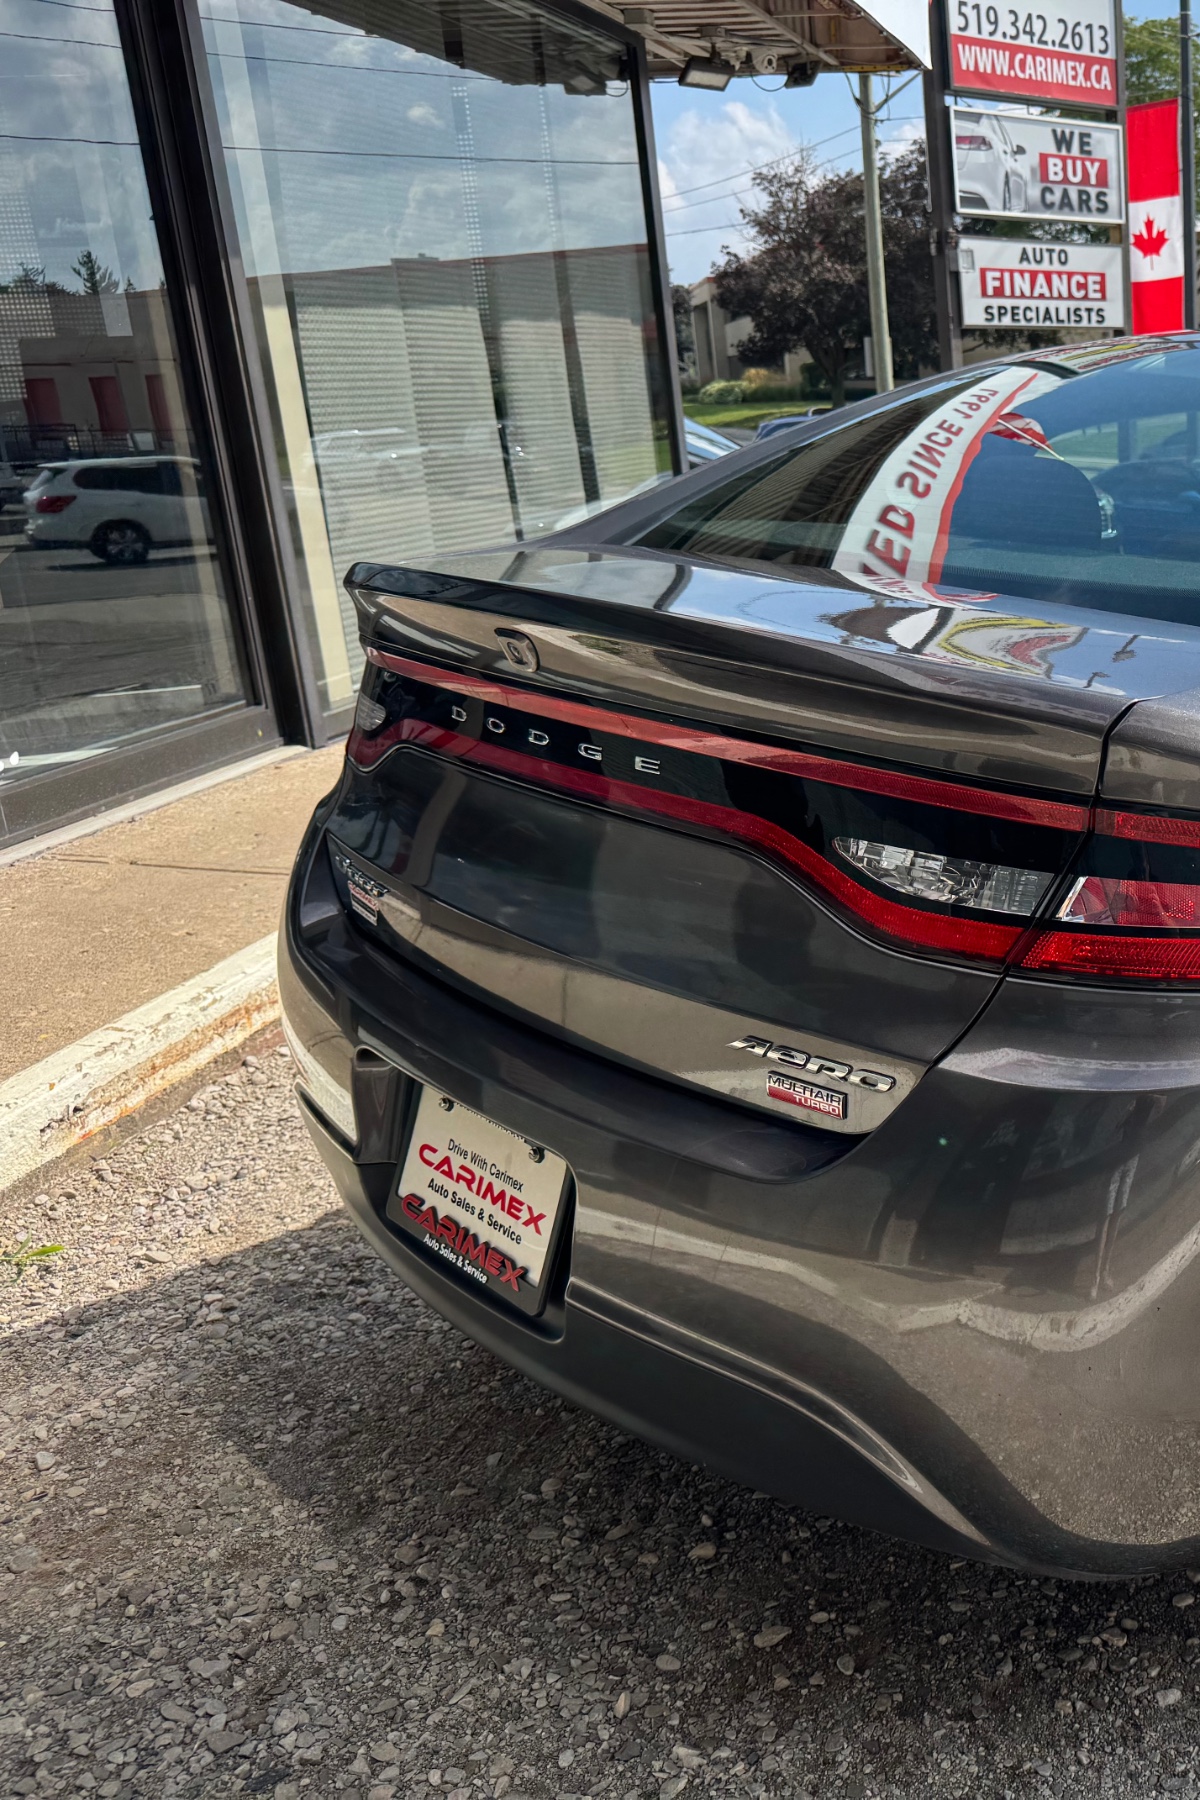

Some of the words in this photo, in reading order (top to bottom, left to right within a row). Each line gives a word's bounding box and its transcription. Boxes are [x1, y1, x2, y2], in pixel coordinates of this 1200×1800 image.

[957, 1, 1110, 55] 519.342.2613
[957, 43, 1112, 90] WWW.CARIMEX.CA
[1051, 128, 1093, 156] WE
[1046, 157, 1101, 185] BUY
[1041, 186, 1109, 214] CARS
[1018, 247, 1069, 266] AUTO
[984, 271, 1102, 299] FINANCE
[983, 305, 1105, 324] SPECIALISTS
[451, 705, 661, 775] DODGE
[767, 1073, 843, 1106] MULTIAIR
[793, 1094, 840, 1116] TURBO
[447, 1138, 469, 1160] Drive
[470, 1151, 488, 1172] With
[489, 1163, 524, 1193] Carimex
[418, 1143, 547, 1236] CARIMEX
[428, 1178, 449, 1198] Auto
[450, 1191, 476, 1216] Sales
[477, 1208, 485, 1222] &
[487, 1214, 522, 1245] Service
[401, 1193, 526, 1292] CARIMEX
[423, 1233, 440, 1250] Auto
[440, 1244, 457, 1264] Sales
[456, 1255, 464, 1268] &
[463, 1259, 488, 1284] Service
